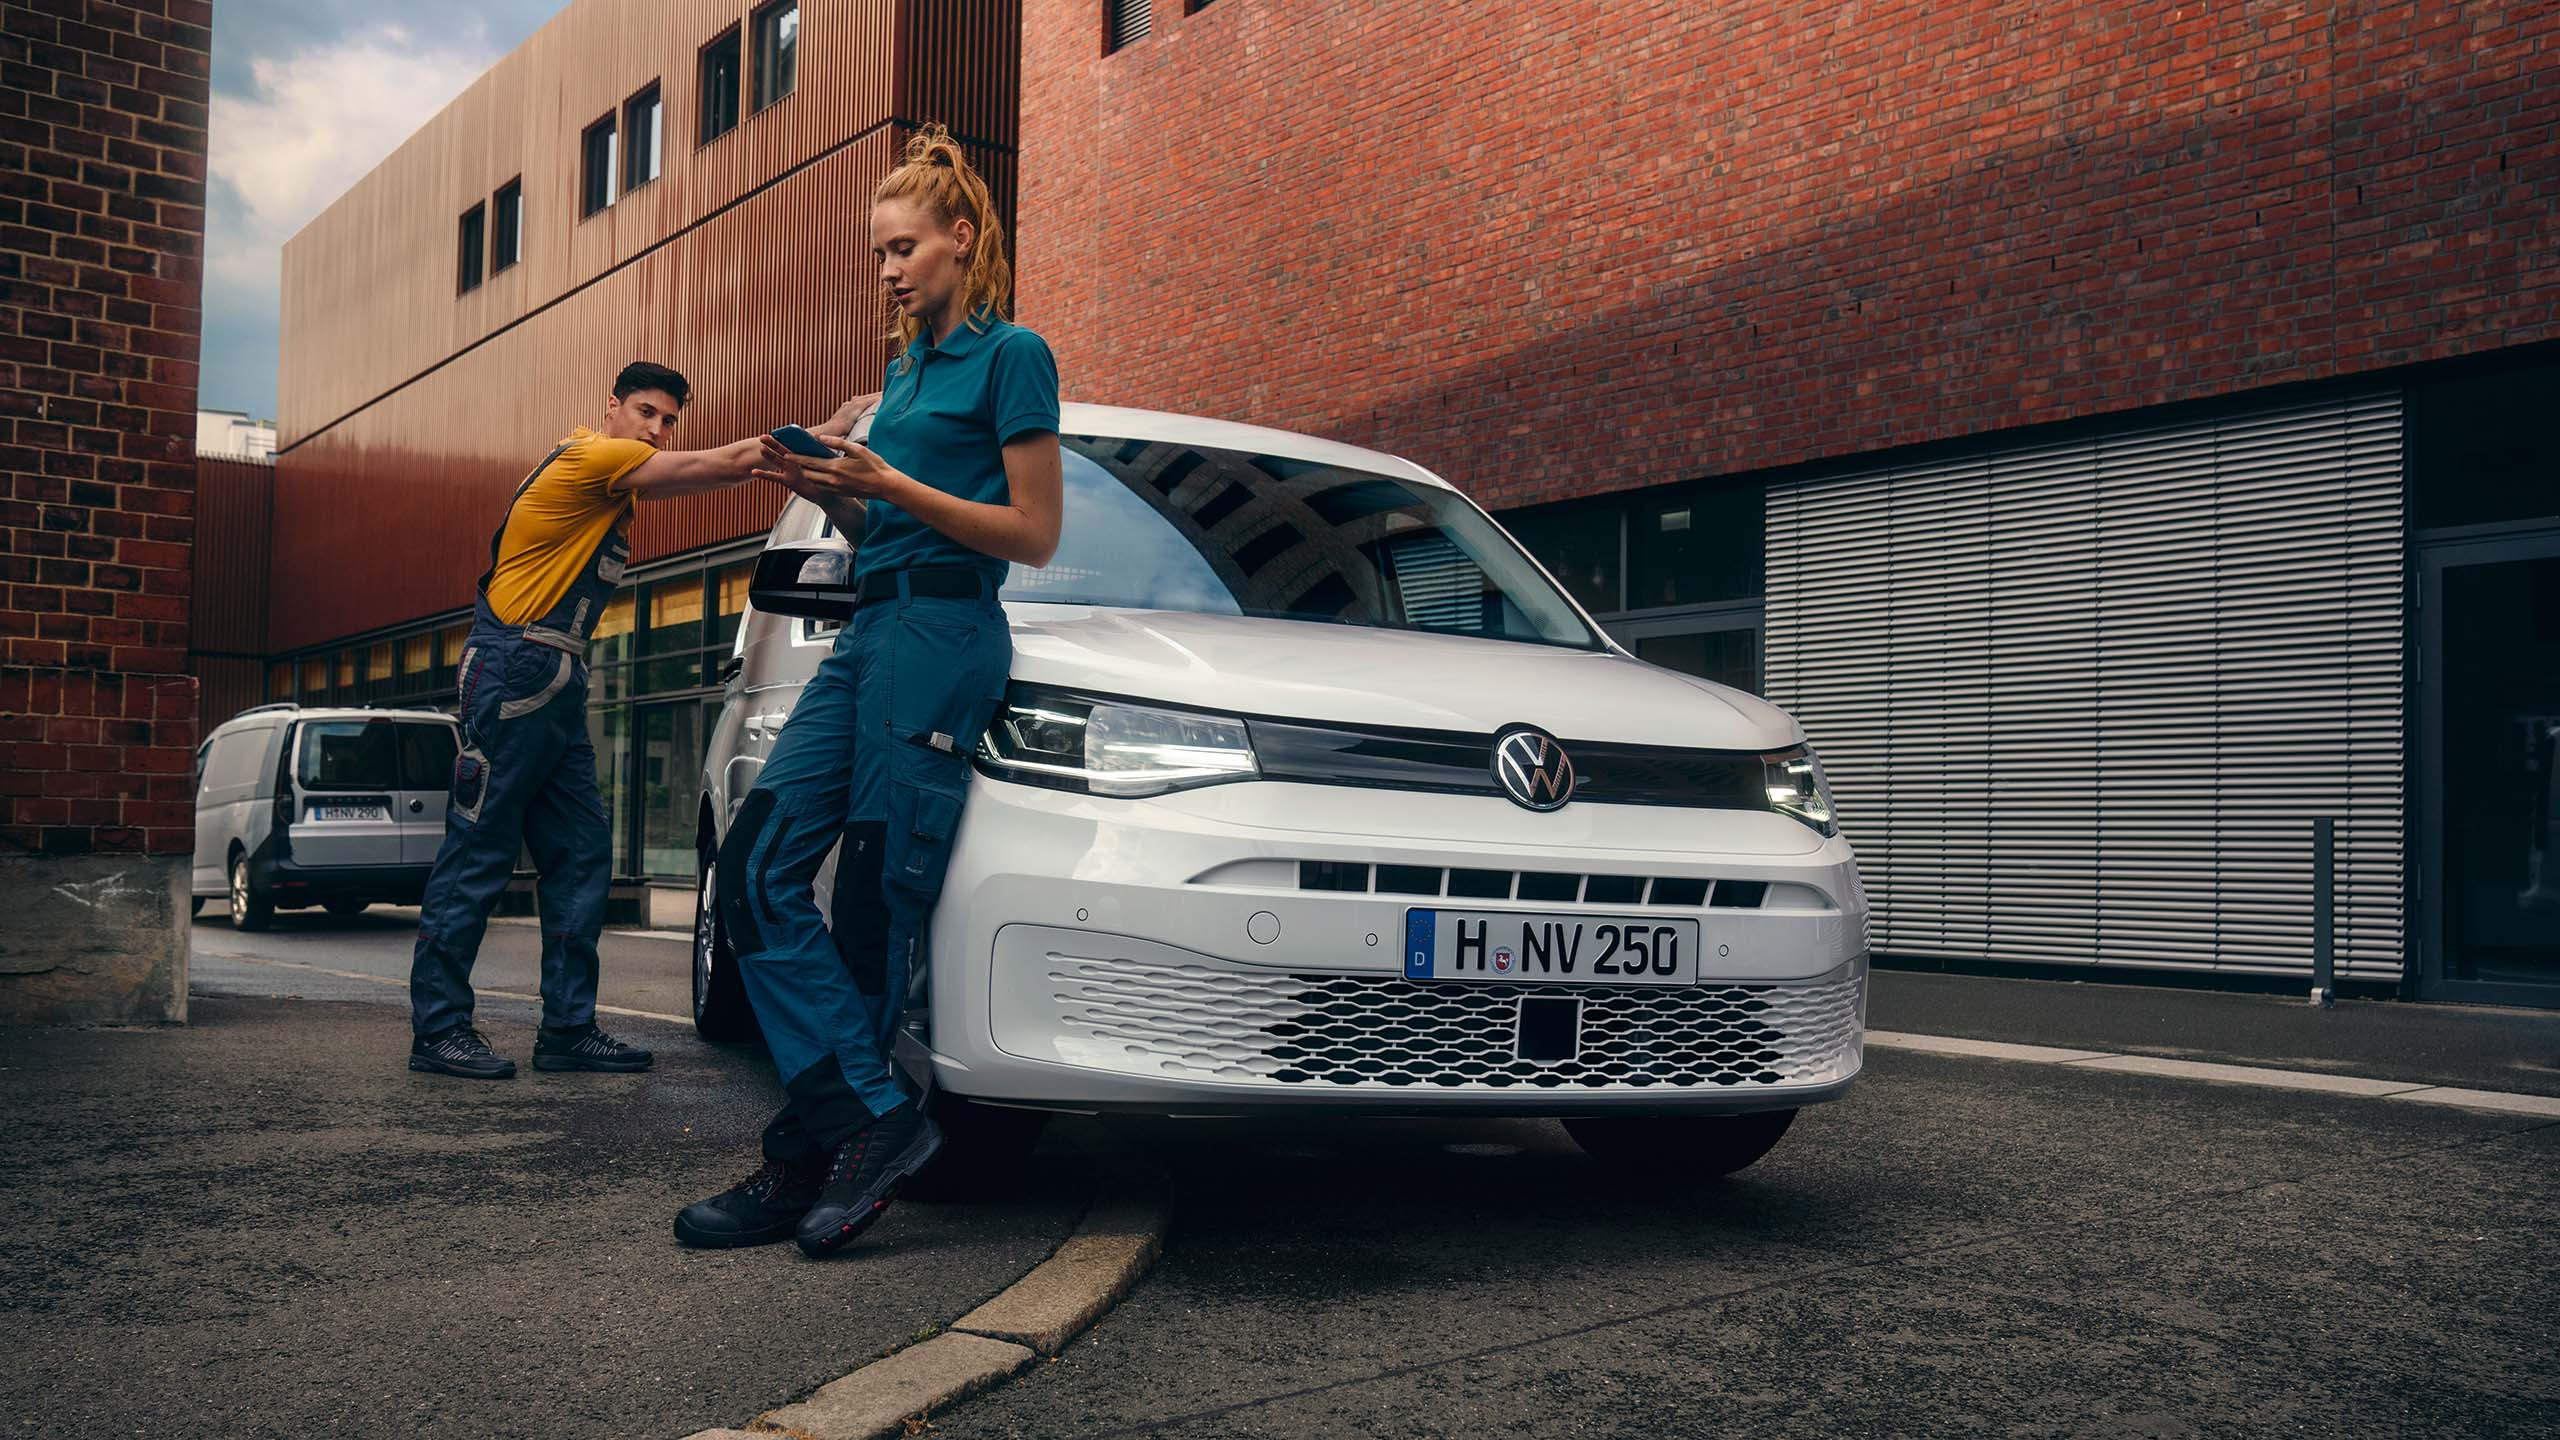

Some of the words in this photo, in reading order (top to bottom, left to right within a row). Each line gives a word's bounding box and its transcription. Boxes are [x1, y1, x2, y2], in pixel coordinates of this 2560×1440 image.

[1499, 734, 1569, 801] VW
[325, 807, 334, 818] H
[341, 807, 356, 818] NV
[358, 807, 378, 818] 290
[1415, 952, 1425, 966] D
[1456, 919, 1487, 970] H
[1522, 922, 1583, 973] NV
[1594, 925, 1678, 976] 250
